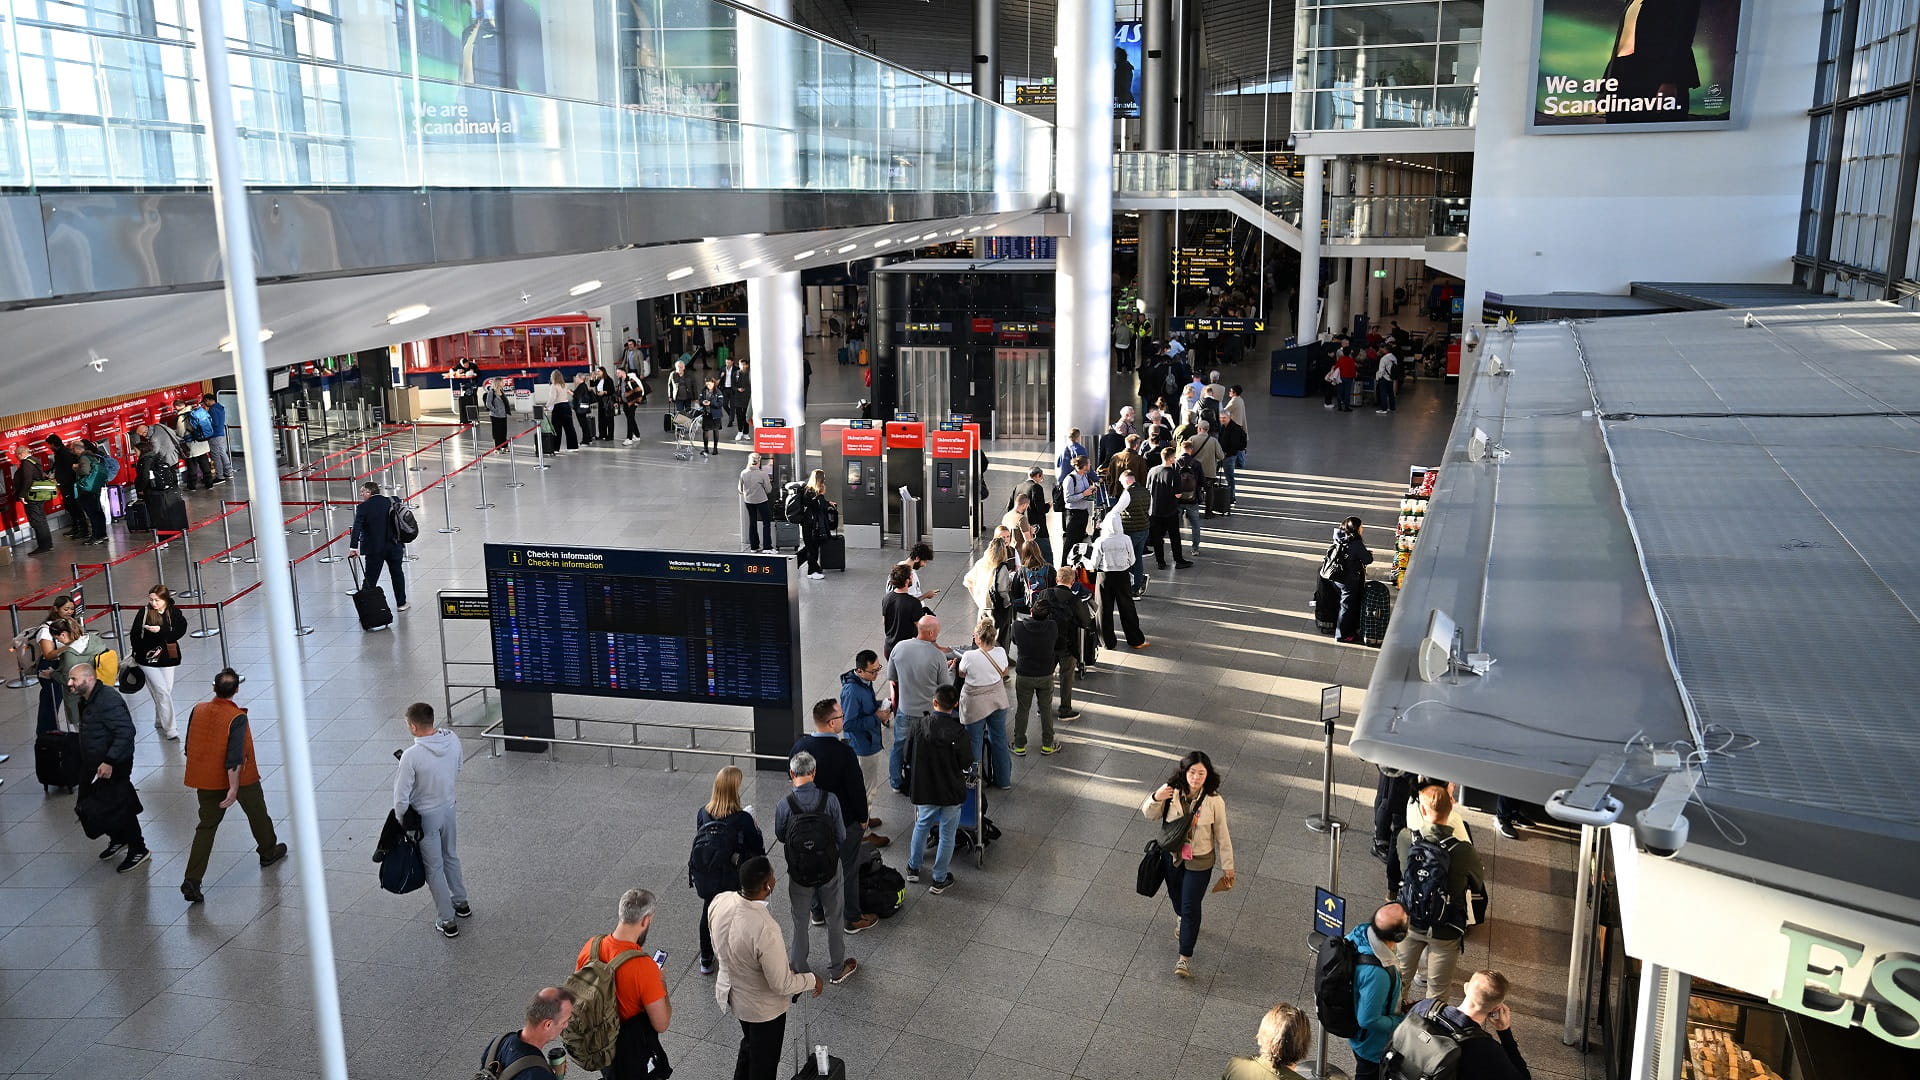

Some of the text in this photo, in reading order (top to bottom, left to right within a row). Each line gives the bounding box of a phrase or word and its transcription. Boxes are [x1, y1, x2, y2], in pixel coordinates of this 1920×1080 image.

[1114, 23, 1142, 42] AS
[1042, 86, 1047, 94] 2
[1545, 76, 1619, 94] We are
[1544, 93, 1682, 114] Scandinavia.
[440, 104, 469, 117] are
[1198, 248, 1204, 256] 2
[711, 316, 717, 326] 1
[1216, 320, 1221, 331] 1
[4, 430, 19, 439] Visit
[62, 415, 73, 425] find
[73, 414, 82, 422] out
[81, 412, 93, 420] how
[98, 407, 107, 417] get
[112, 404, 124, 413] your
[123, 398, 147, 409] destination
[527, 550, 603, 561] Check-in information
[527, 558, 604, 569] Check-in information
[723, 563, 731, 573] 3
[1768, 921, 1920, 1050] ES
